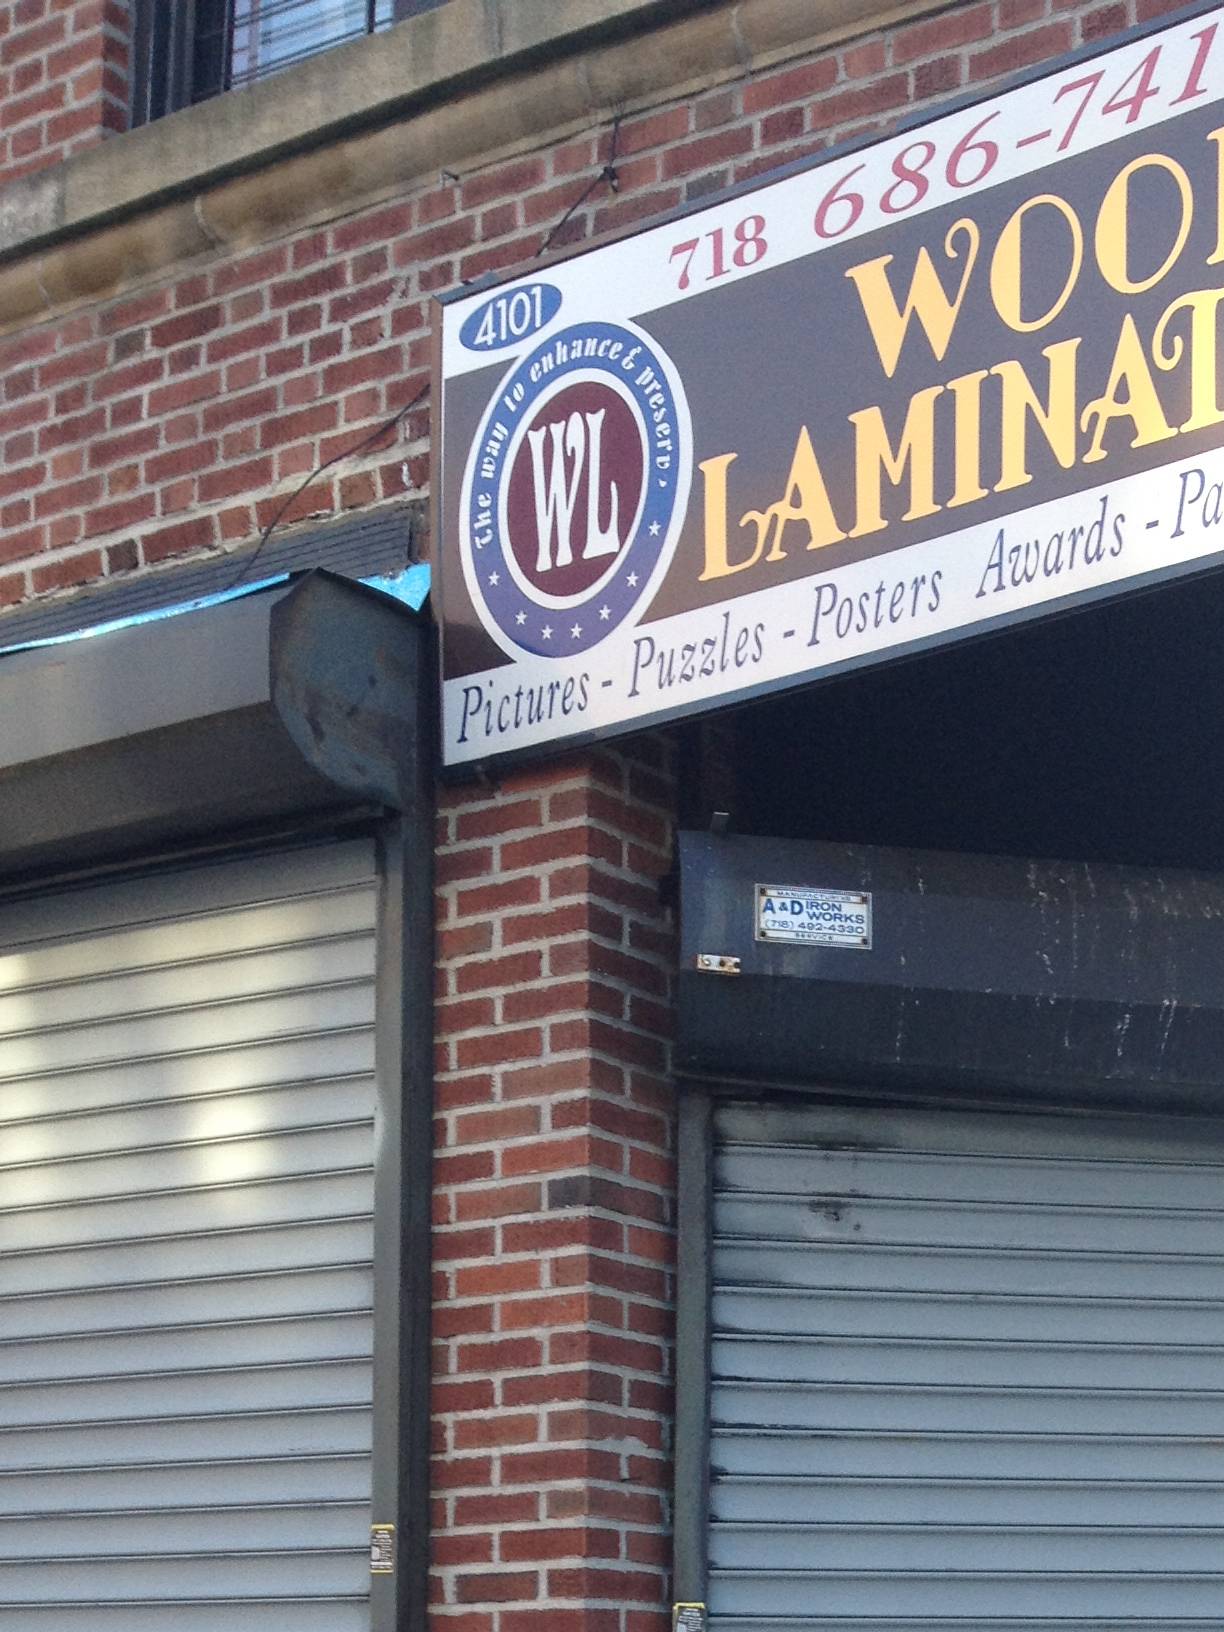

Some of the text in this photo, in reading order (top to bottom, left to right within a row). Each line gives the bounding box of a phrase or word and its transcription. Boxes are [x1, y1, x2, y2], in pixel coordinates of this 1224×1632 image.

[669, 214, 769, 291] 718
[474, 285, 542, 347] 4101
[503, 380, 526, 414] to
[529, 334, 624, 383] enhance
[634, 365, 673, 488] preserv
[526, 407, 620, 572] WL
[456, 671, 590, 744] Pictures
[628, 612, 767, 698] Puzzles
[807, 567, 944, 648] Posters
[975, 495, 1127, 598] Awards
[805, 900, 843, 912] IRON
[806, 911, 865, 925] WORKS
